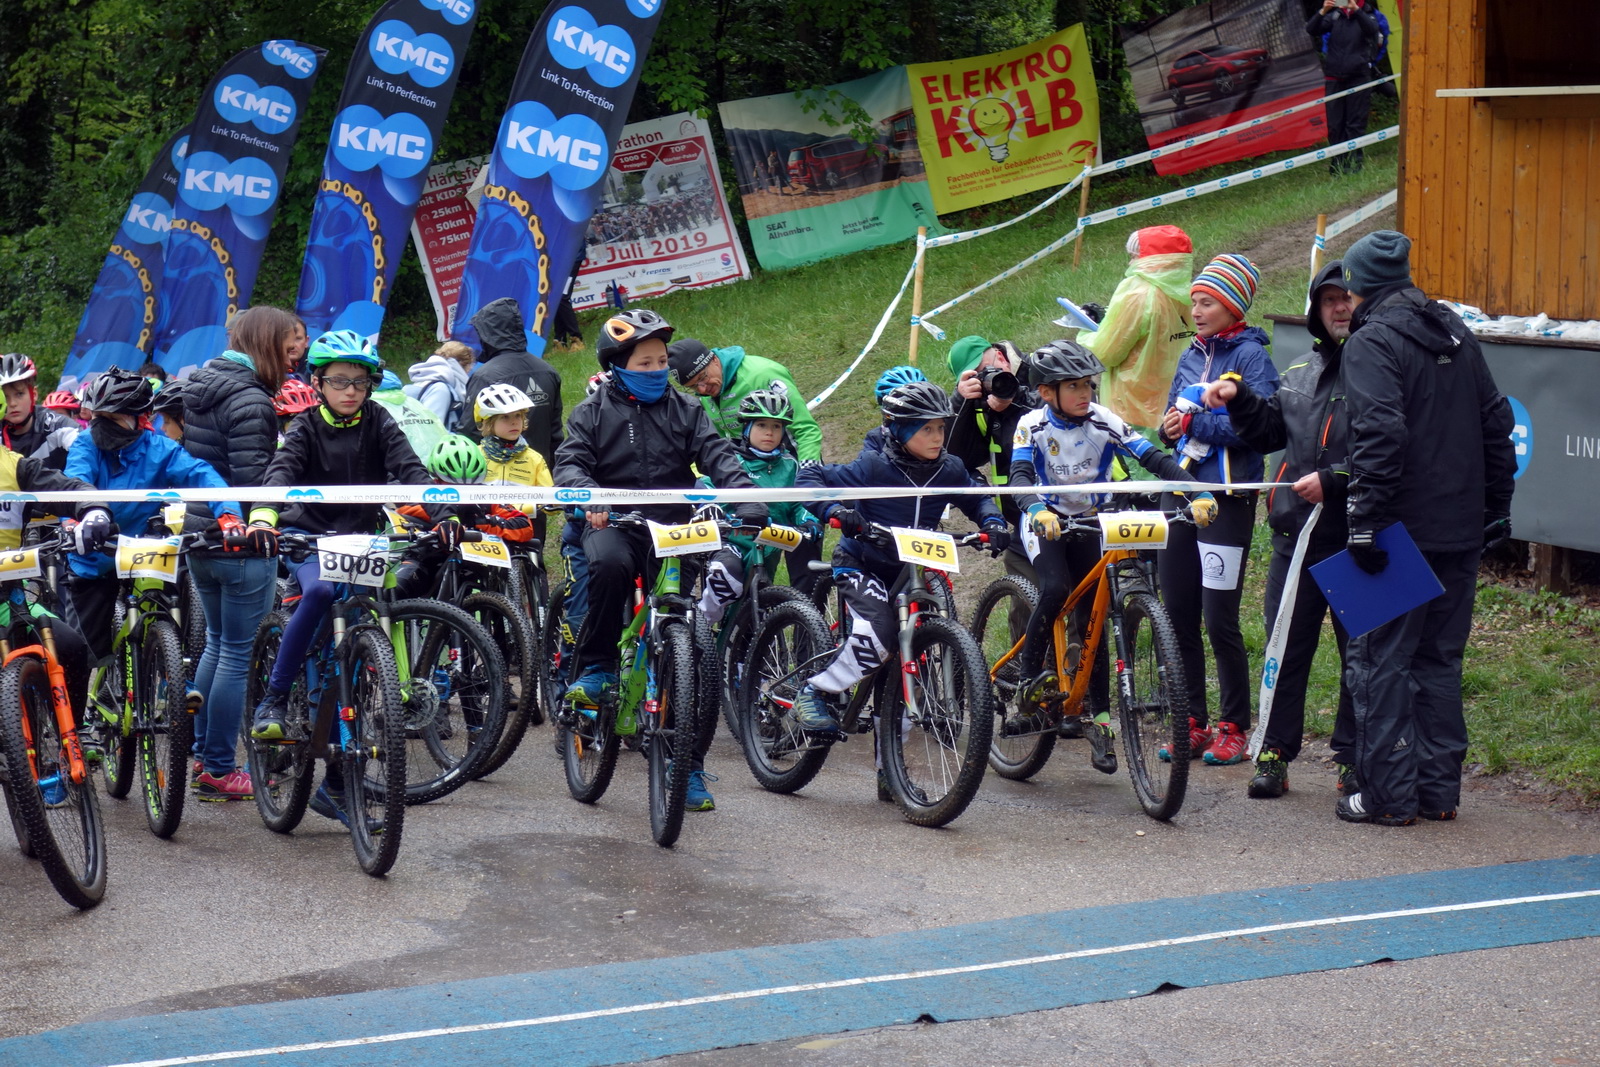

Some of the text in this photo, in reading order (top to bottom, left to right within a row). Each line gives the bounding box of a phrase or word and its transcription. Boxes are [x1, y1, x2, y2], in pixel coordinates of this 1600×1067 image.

[266, 41, 313, 74] KMC
[376, 32, 449, 75] KMC
[553, 19, 630, 74] KMC
[921, 44, 1072, 104] ELEKTRO
[367, 75, 436, 108] Link To Perfection
[541, 68, 614, 112] Link To Perfection
[220, 86, 291, 123] KMC
[930, 78, 1083, 158] KOLB
[211, 125, 279, 153] Link To Perfection
[338, 123, 425, 160] KMC
[506, 120, 601, 171] KMC
[670, 145, 686, 153] TOP
[619, 155, 639, 163] 1000
[947, 150, 1063, 183] Fachbetrieb für Gebäudetechnik
[162, 173, 178, 186] Link
[184, 169, 272, 199] KMC
[436, 188, 463, 202] KIDS
[127, 204, 173, 233] KM
[431, 205, 462, 219] 25km
[436, 218, 467, 232] 50km
[440, 231, 471, 245] 75km
[766, 221, 787, 231] SEAT
[768, 226, 814, 240] Alhambra.
[606, 243, 643, 262] Juli
[651, 231, 708, 256] 2019
[425, 492, 459, 501] KMC
[499, 492, 544, 500] PERFECTION
[558, 491, 591, 500] KMC
[668, 524, 708, 540] 676
[1118, 523, 1156, 538] 677
[132, 552, 168, 567] 671
[471, 542, 501, 555] 668
[911, 541, 947, 558] 675
[323, 553, 386, 577] 8008
[709, 569, 739, 604] FOX
[561, 623, 577, 645] FOX
[852, 633, 882, 676] FOX
